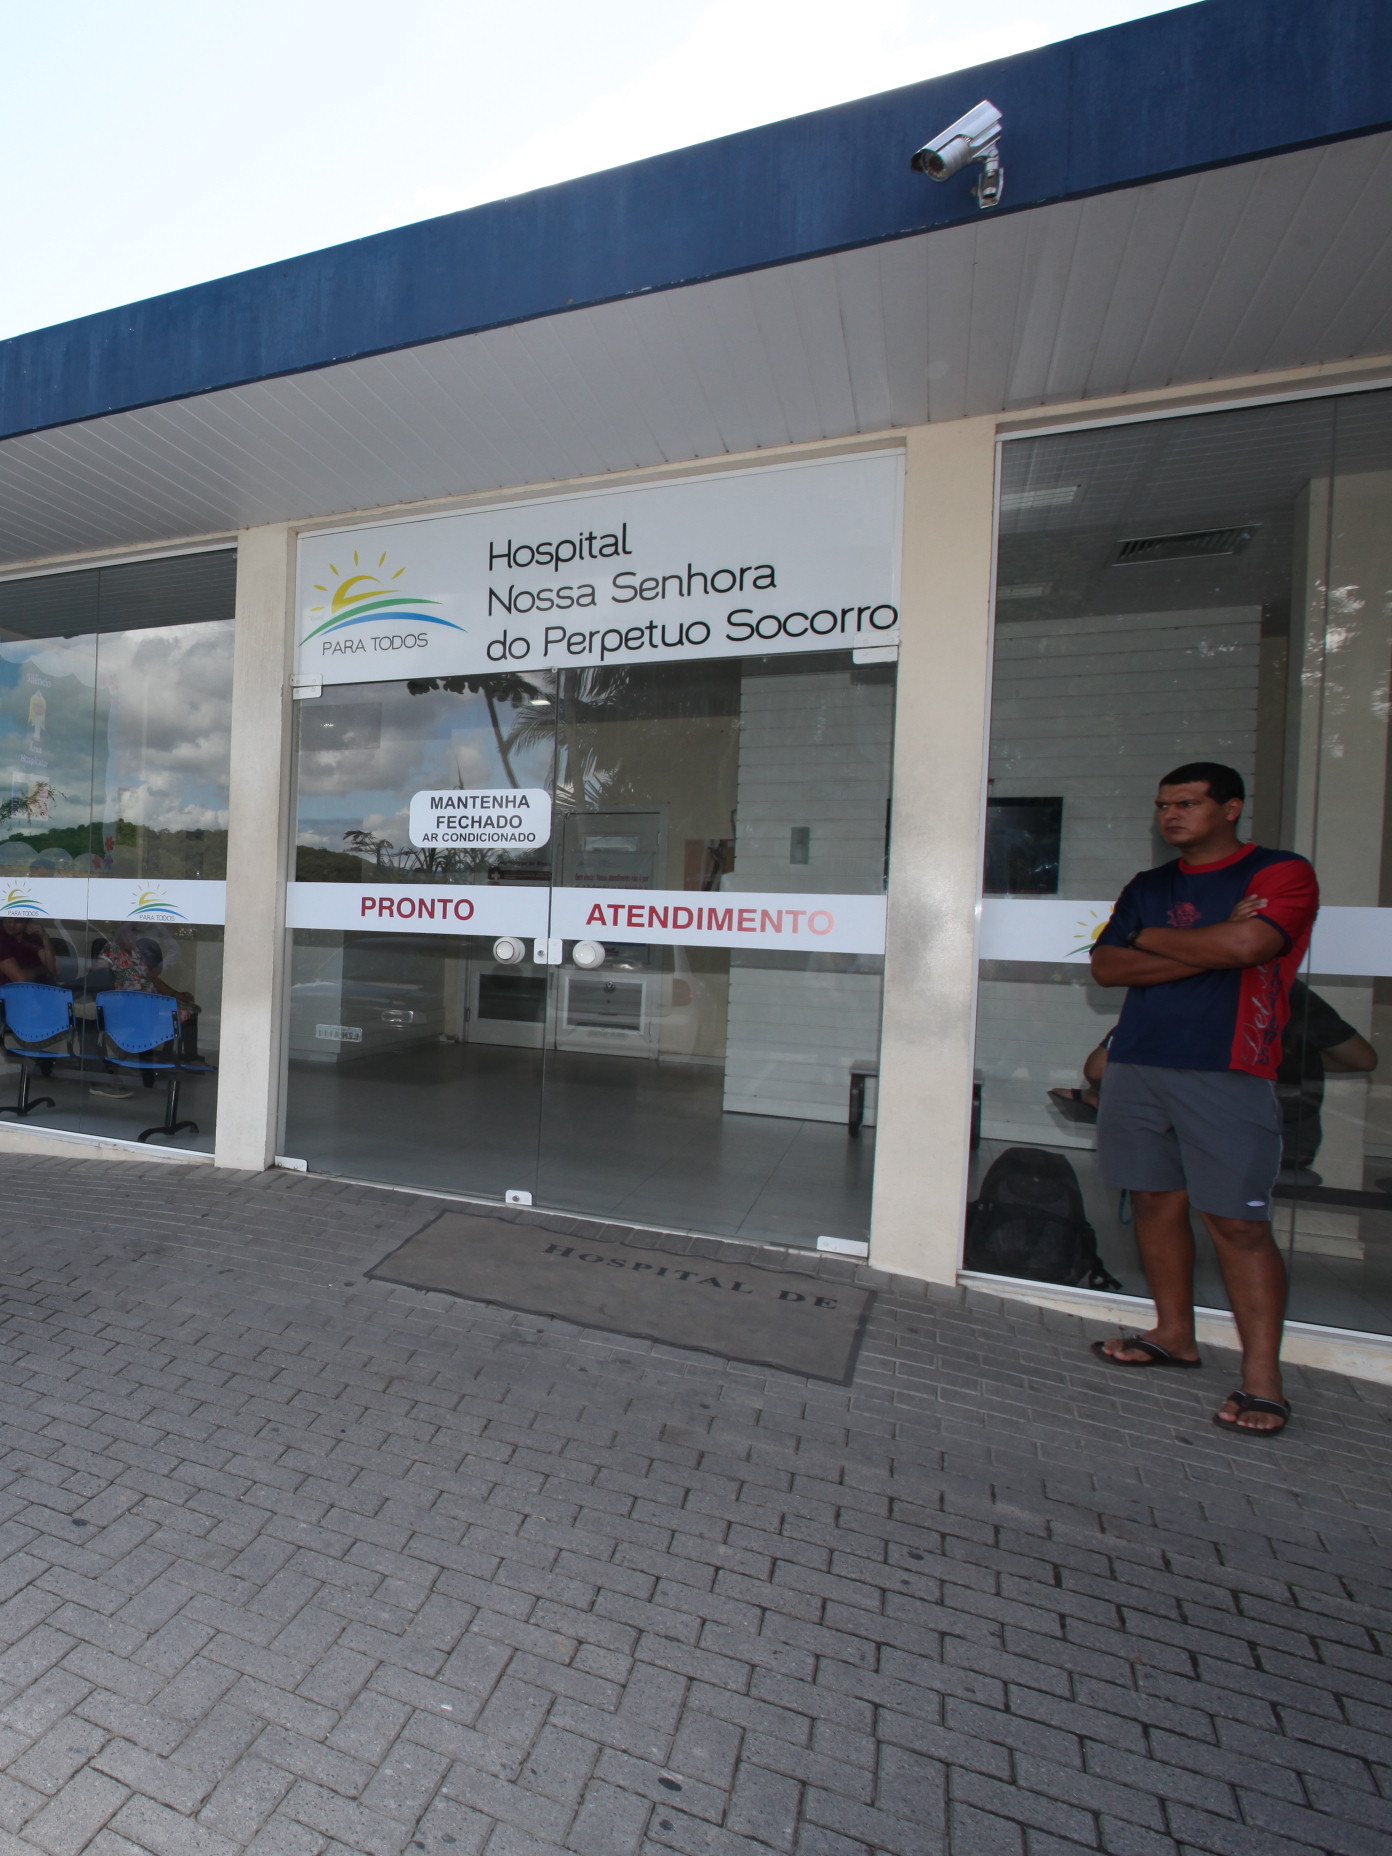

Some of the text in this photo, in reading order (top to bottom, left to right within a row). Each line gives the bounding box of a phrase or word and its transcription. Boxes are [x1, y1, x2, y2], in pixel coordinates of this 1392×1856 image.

[489, 522, 633, 573] Hospital
[488, 562, 777, 617] Nossa Senhora
[322, 632, 429, 656] PARA TODOS
[486, 604, 899, 662] do Perpetuo Socorro
[430, 794, 531, 810] MANTENHA
[422, 832, 536, 843] AR CONDICIONADO
[436, 814, 523, 830] FECHADO
[156, 914, 175, 922] TODOS
[360, 896, 836, 935] PRONTO ATENDIMENTO
[542, 1243, 838, 1310] HOSPITAL DE
